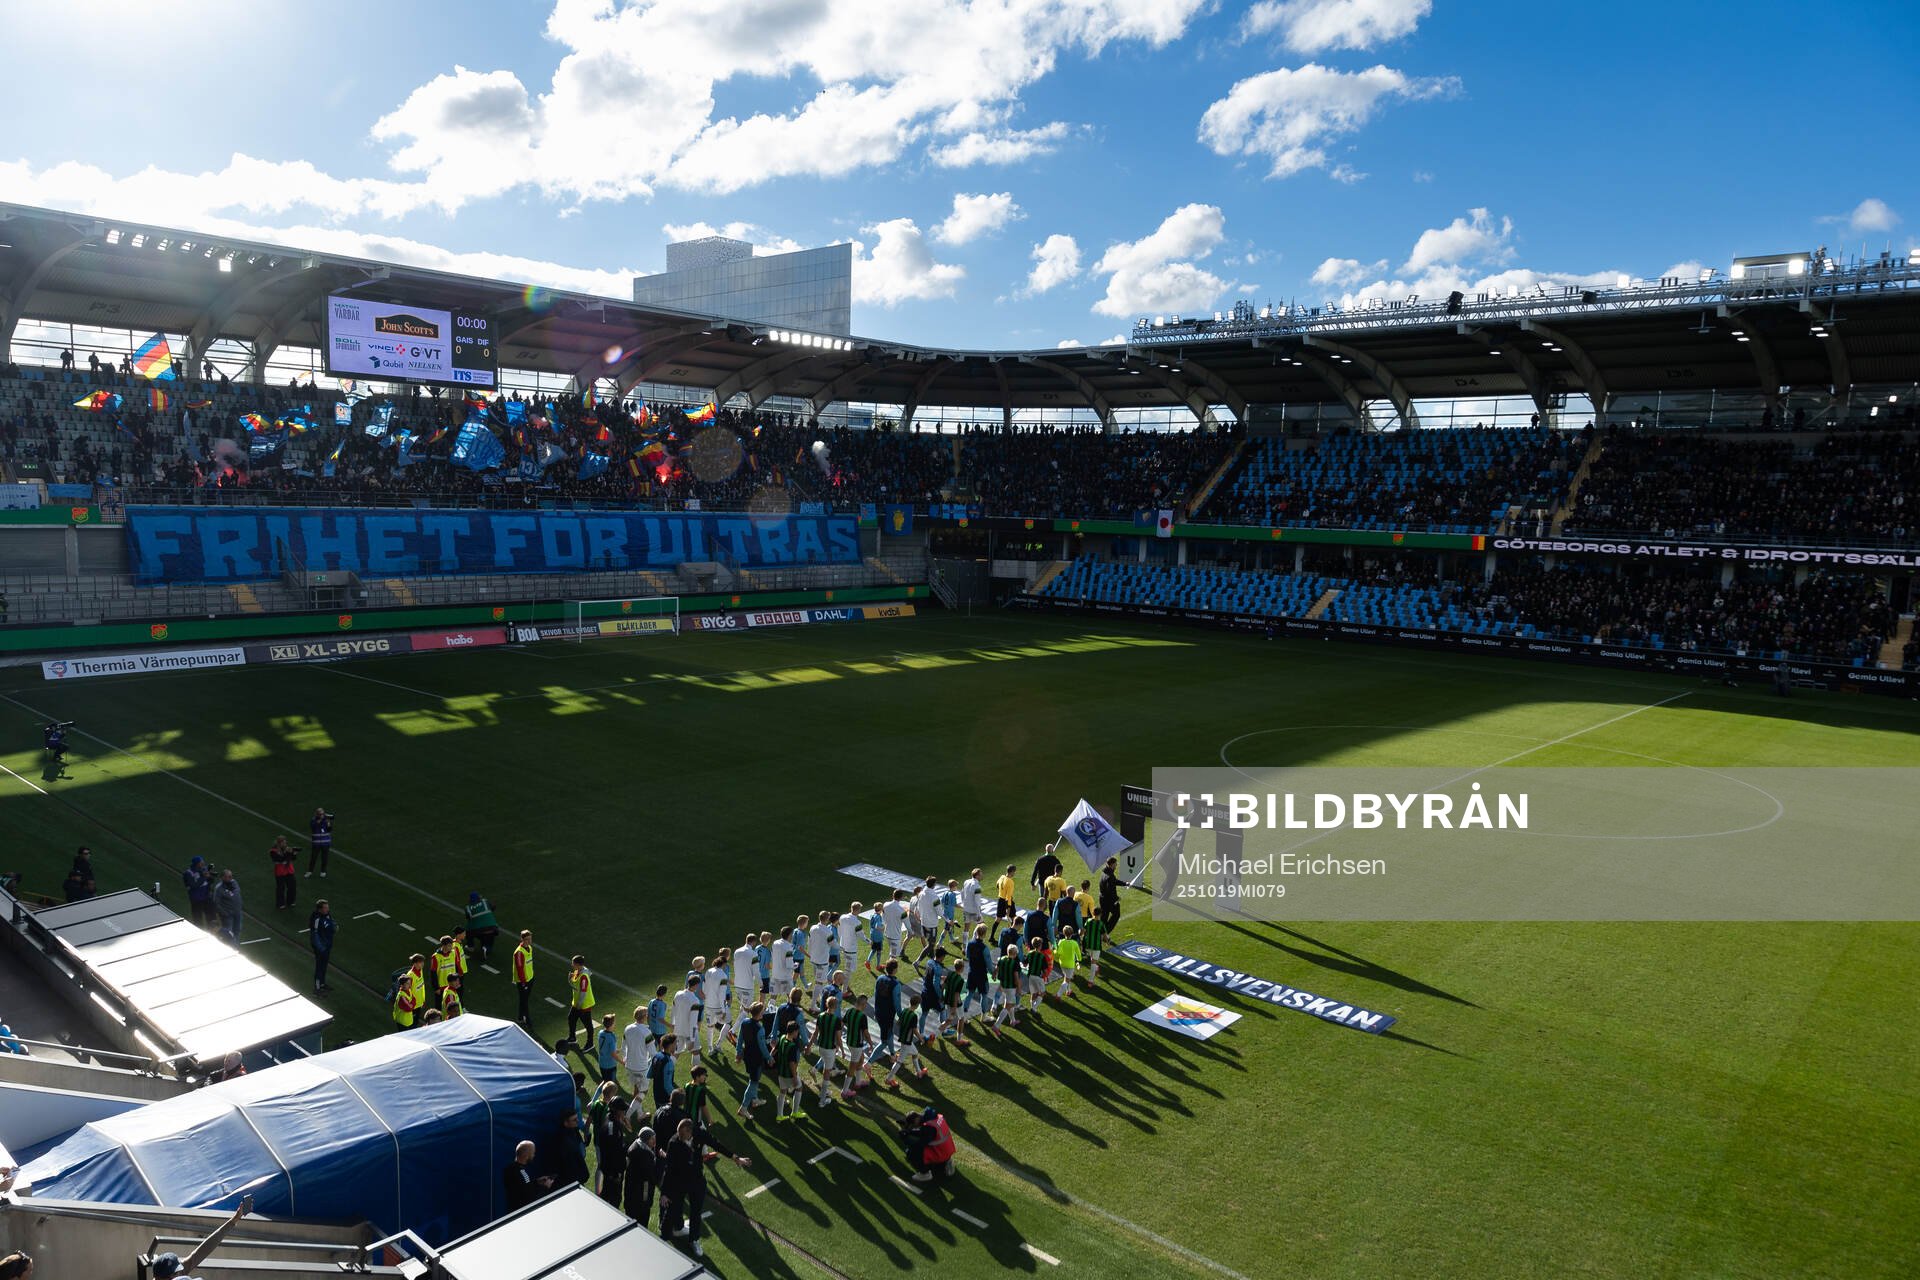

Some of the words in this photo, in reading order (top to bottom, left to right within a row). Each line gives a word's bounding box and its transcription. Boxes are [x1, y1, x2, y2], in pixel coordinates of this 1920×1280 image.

[457, 316, 487, 330] 00:00
[455, 336, 473, 345] GAIS
[477, 338, 489, 346] DIF
[455, 345, 462, 354] 0
[484, 348, 490, 357] 0
[382, 360, 404, 369] Qubit
[408, 361, 442, 370] NIELSEN
[453, 370, 472, 381] ITS
[132, 515, 470, 578] FRIHET
[1493, 538, 1632, 554] GÖTEBORGS
[1635, 545, 1717, 557] ATLET-
[1721, 548, 1740, 559] &
[755, 612, 801, 624] CRAMO
[815, 610, 847, 620] DAHL
[446, 634, 473, 646] habo
[517, 627, 540, 642] BOA
[303, 639, 390, 657] XL-BYGG
[72, 659, 135, 674] Thermia
[140, 651, 241, 668] Värmepumpar
[1127, 792, 1159, 806] UNIBET
[1201, 807, 1230, 820] UNIBE
[1153, 954, 1383, 1032] ALLSVENSKAN
